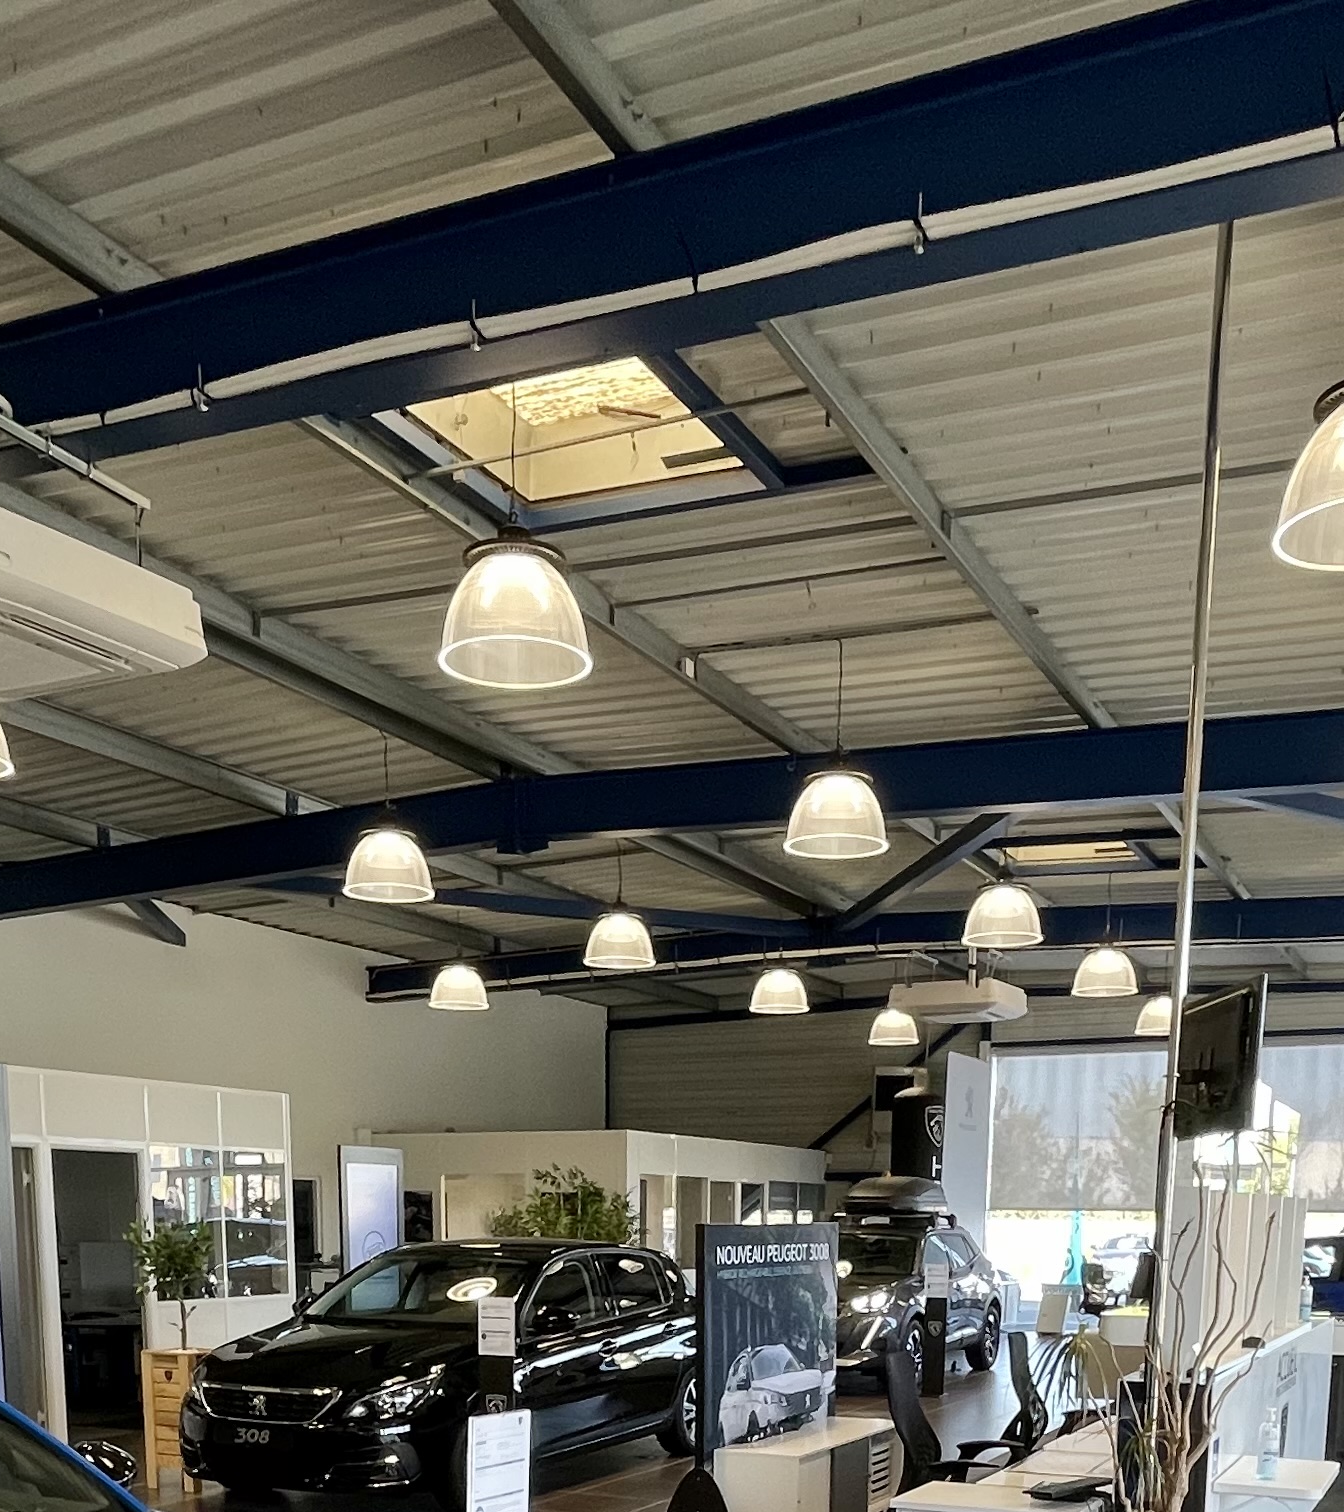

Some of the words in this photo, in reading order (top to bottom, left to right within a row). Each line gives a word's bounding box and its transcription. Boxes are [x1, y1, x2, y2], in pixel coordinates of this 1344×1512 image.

[716, 1245, 766, 1266] NOUVEAU
[766, 1243, 809, 1264] PEUGEOT
[233, 1427, 271, 1444] 308
